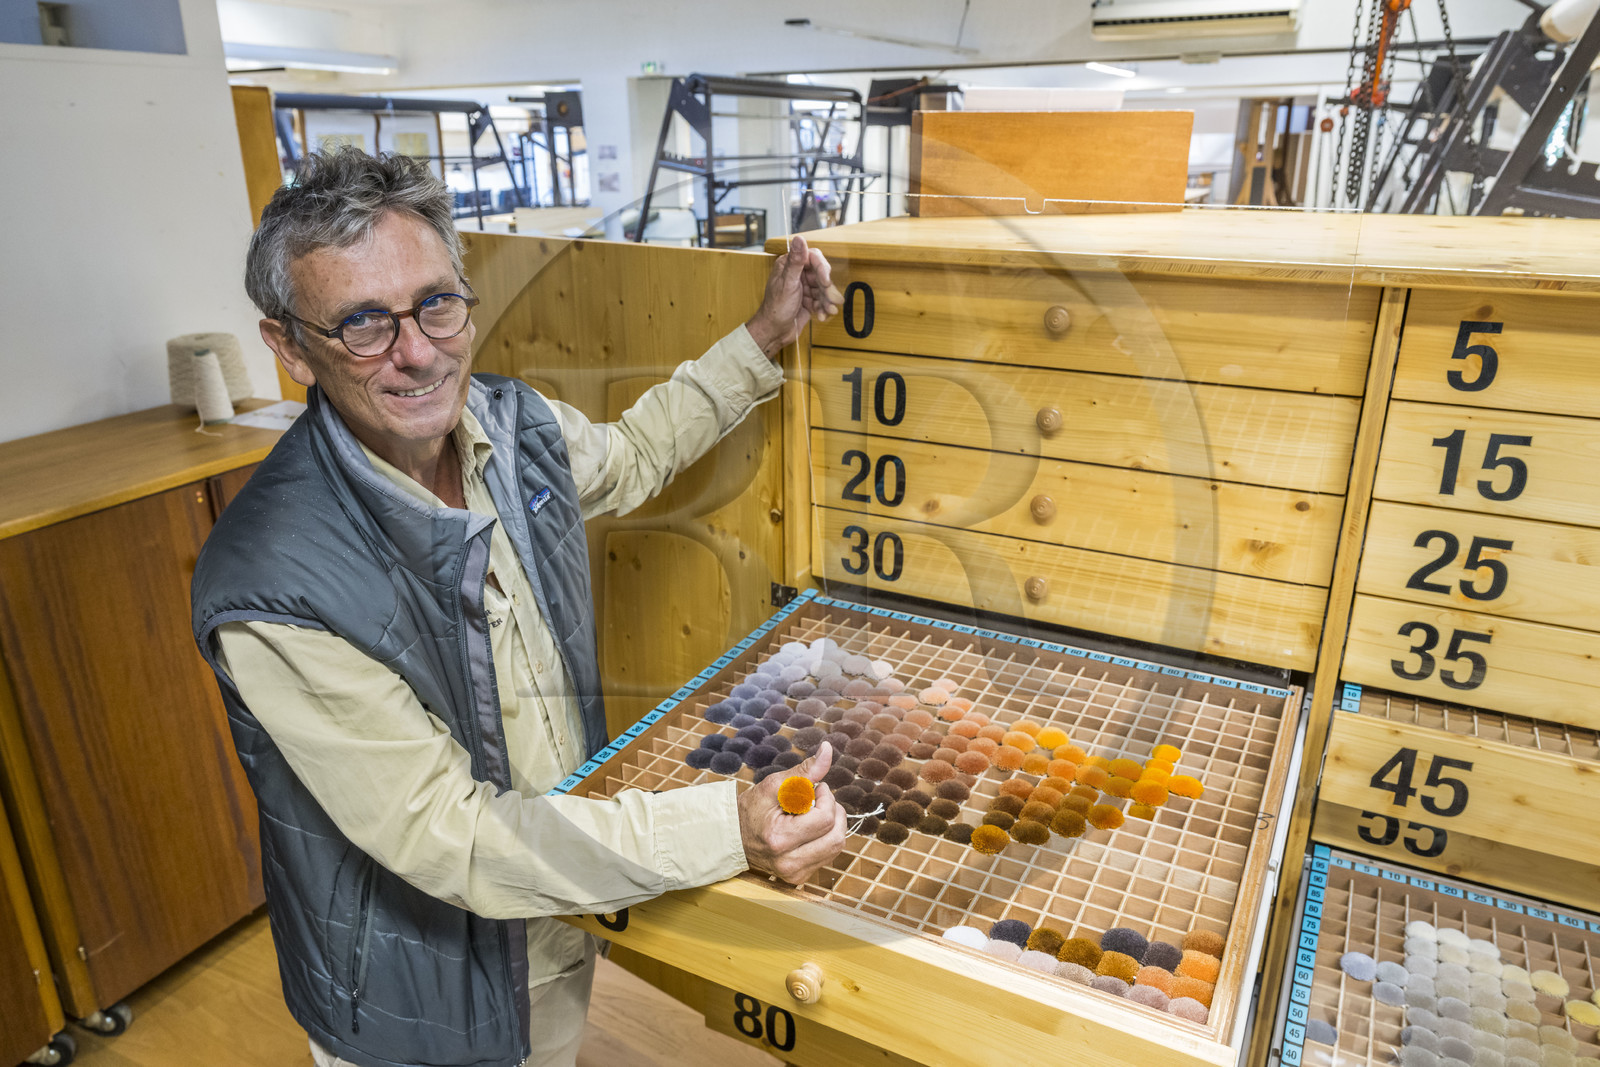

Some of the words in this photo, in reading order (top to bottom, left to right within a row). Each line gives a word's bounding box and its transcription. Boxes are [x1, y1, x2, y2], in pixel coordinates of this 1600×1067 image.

[843, 281, 875, 339] 0
[1447, 321, 1504, 392] 5
[843, 368, 906, 426] 10
[1432, 429, 1533, 501] 15
[842, 450, 905, 506] 20
[842, 526, 903, 581] 30
[1406, 530, 1514, 601] 25
[1392, 621, 1493, 690] 35
[582, 765, 594, 773] 15
[563, 779, 576, 787] 10
[1370, 747, 1474, 817] 45
[1311, 890, 1321, 898] 85
[1388, 872, 1401, 880] 10
[1417, 879, 1429, 888] 15
[1444, 886, 1458, 895] 20
[1474, 893, 1487, 903] 25
[1503, 901, 1518, 910] 30
[1533, 908, 1548, 918] 35
[1565, 917, 1579, 926] 40
[1308, 904, 1319, 913] 80
[1307, 920, 1316, 929] 75
[1304, 936, 1314, 946] 70
[1301, 953, 1311, 963] 65
[1298, 970, 1309, 980] 60
[1294, 989, 1306, 999] 55
[1292, 1008, 1303, 1019] 50
[733, 992, 796, 1052] 80
[1289, 1028, 1300, 1038] 45
[1285, 1049, 1297, 1060] 40
